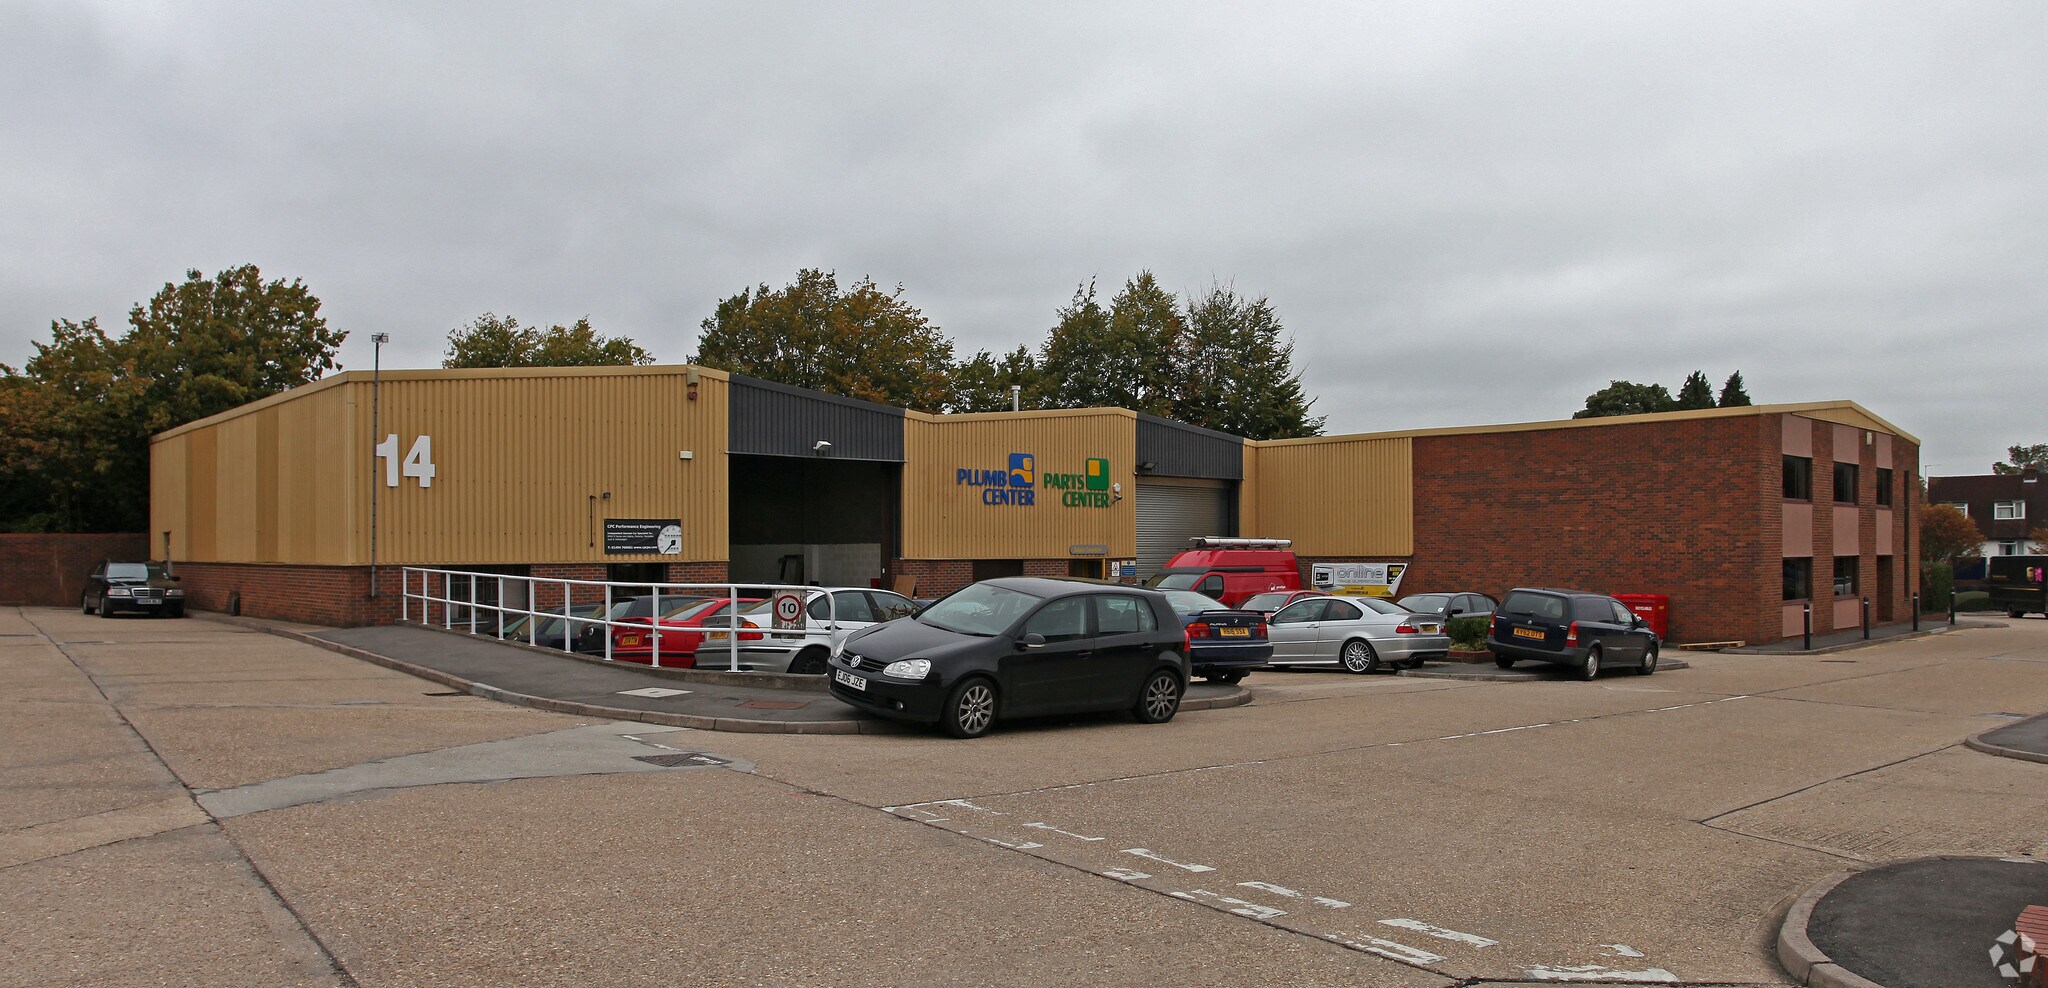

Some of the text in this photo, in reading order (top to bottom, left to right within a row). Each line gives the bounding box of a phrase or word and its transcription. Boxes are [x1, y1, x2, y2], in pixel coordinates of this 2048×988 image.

[376, 434, 436, 487] 14
[956, 468, 1007, 487] PLUMB
[1043, 473, 1085, 490] PARTS
[982, 488, 1035, 506] CENTER
[1061, 491, 1110, 509] CENTER
[1337, 564, 1384, 579] online
[782, 603, 796, 613] 10
[838, 670, 864, 688] EJ06 JZE
